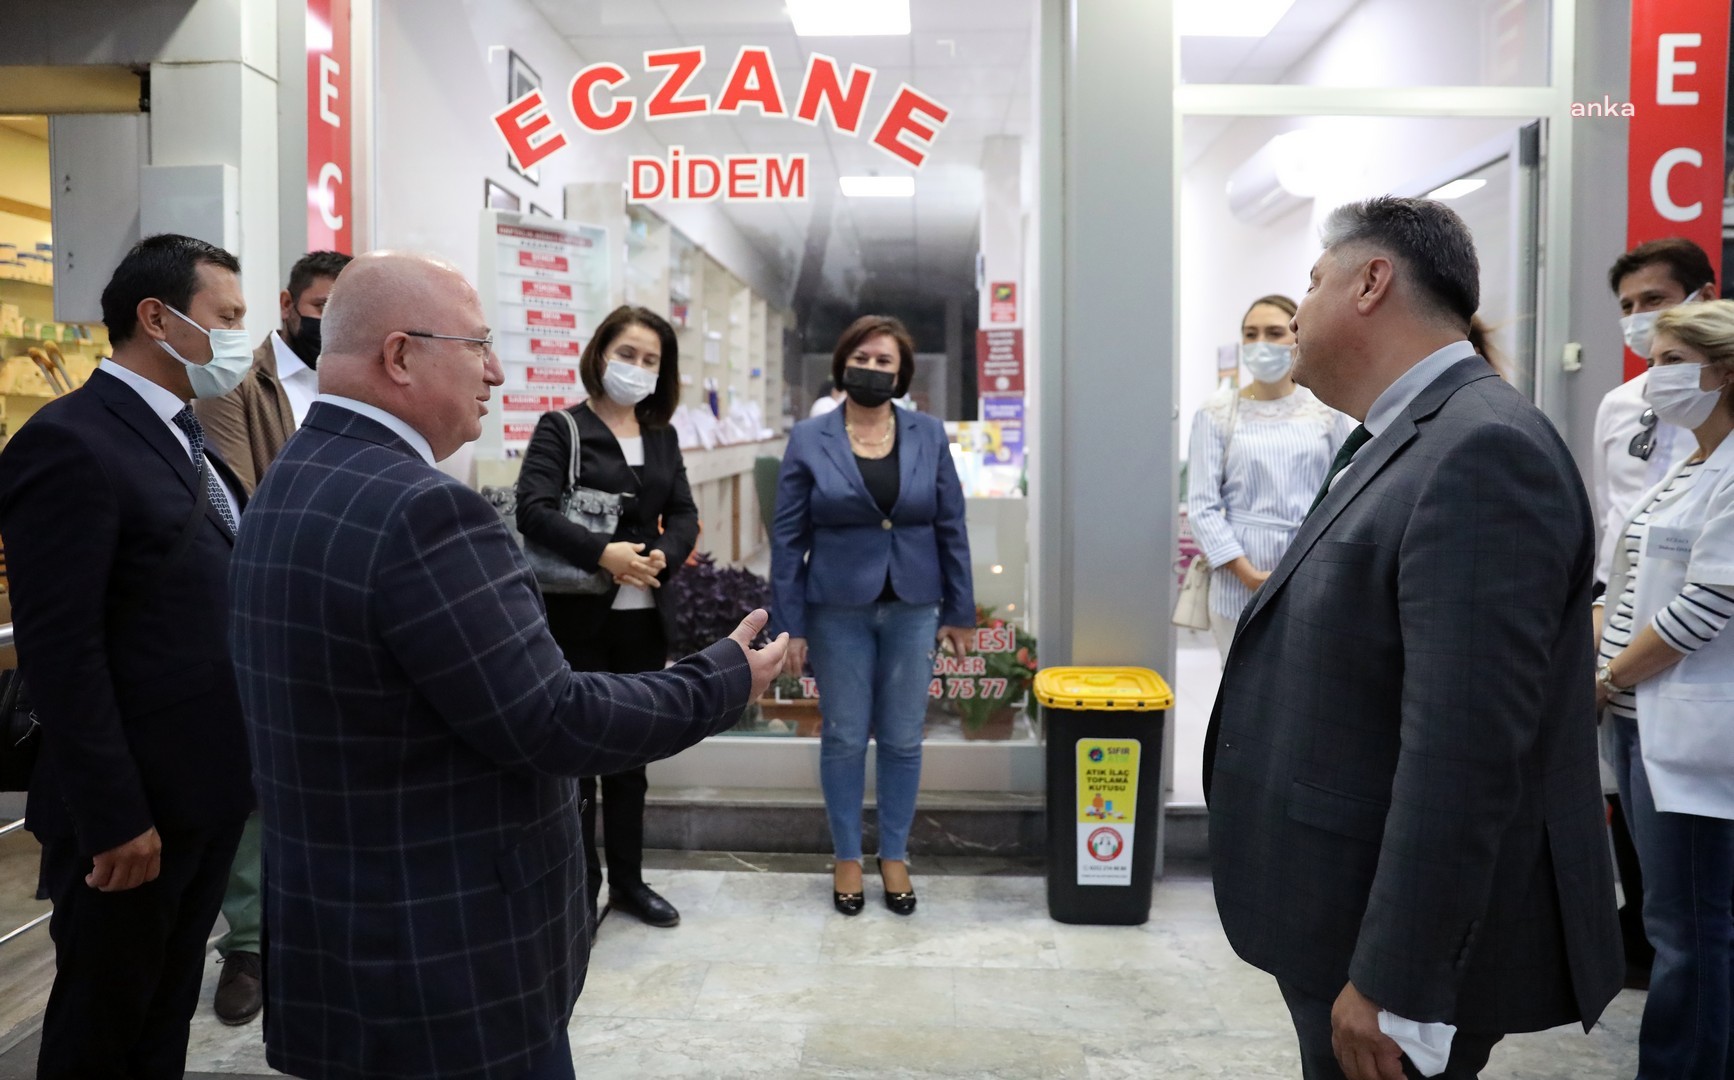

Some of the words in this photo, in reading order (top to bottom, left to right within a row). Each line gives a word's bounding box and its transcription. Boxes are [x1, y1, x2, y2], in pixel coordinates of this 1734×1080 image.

[491, 46, 951, 173] ECZANE
[629, 146, 807, 202] DİDEM
[976, 624, 1016, 652] ESİ
[946, 678, 975, 698] 75
[979, 678, 1008, 698] 77
[1107, 747, 1130, 755] SIFIR
[1109, 768, 1129, 777] İLAÇ
